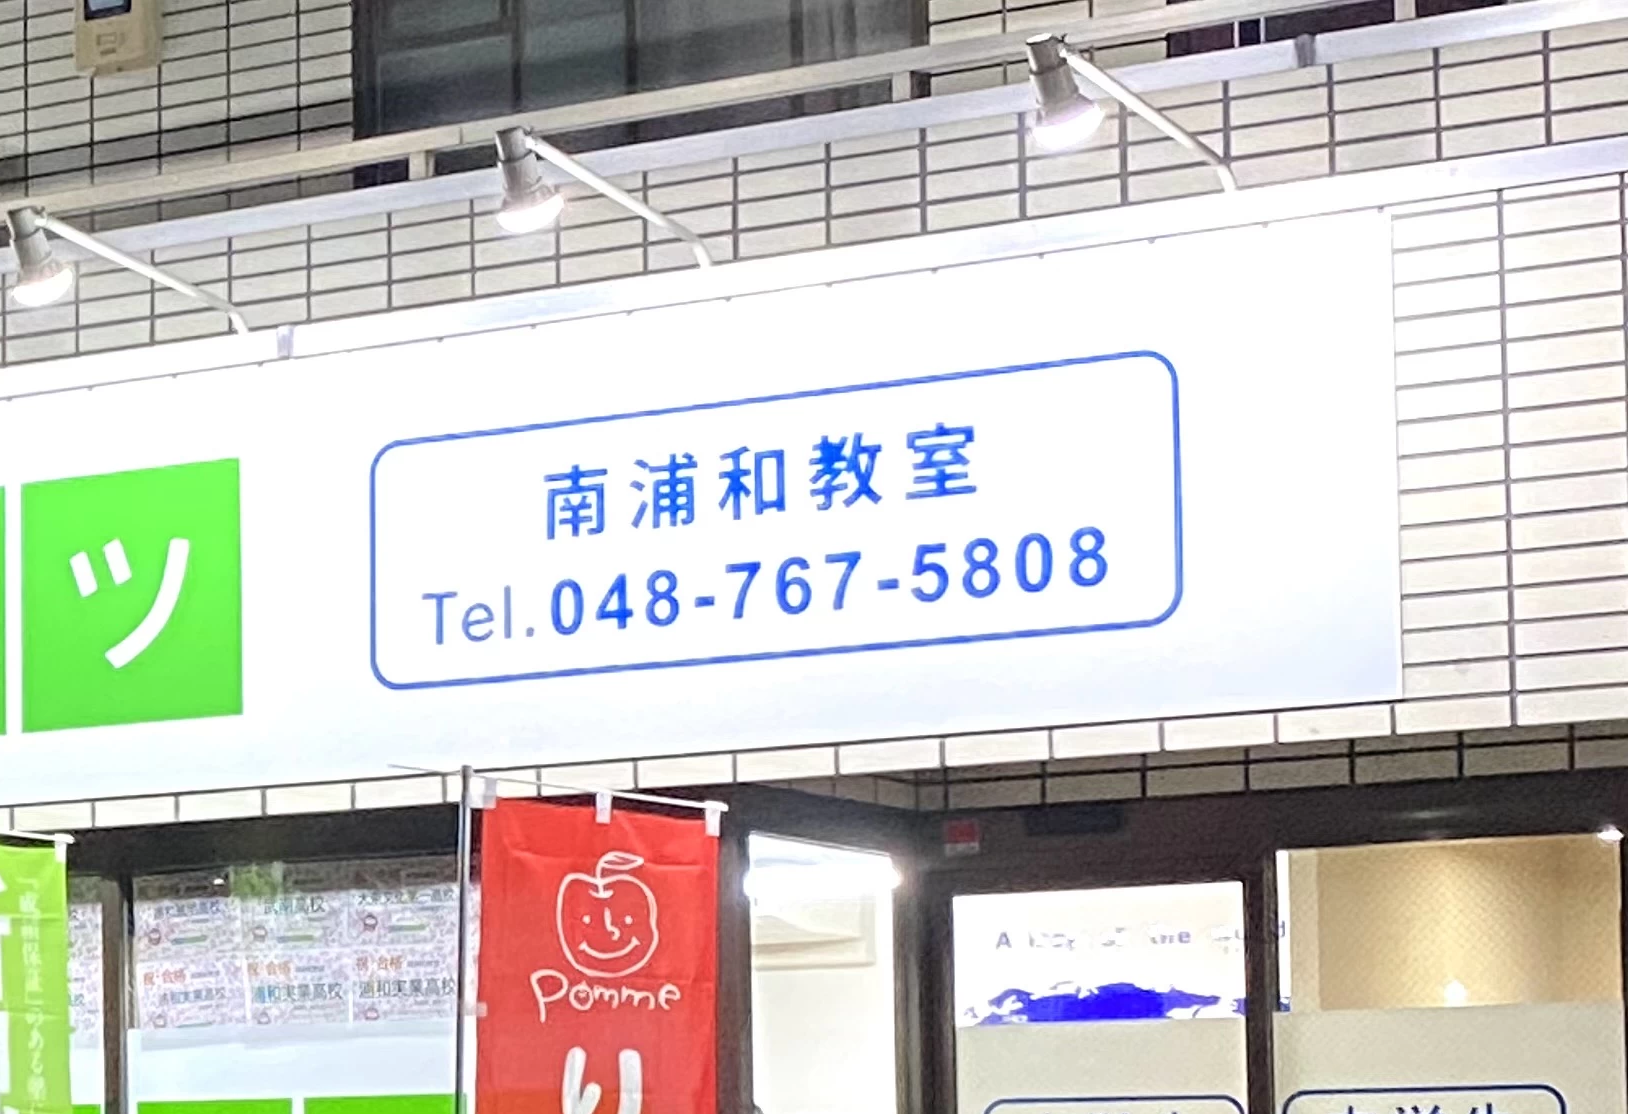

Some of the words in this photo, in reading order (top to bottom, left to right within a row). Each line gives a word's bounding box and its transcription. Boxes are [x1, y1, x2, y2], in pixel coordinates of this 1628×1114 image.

[544, 423, 978, 540] 南浦和教室
[530, 968, 681, 1022] Pomme
